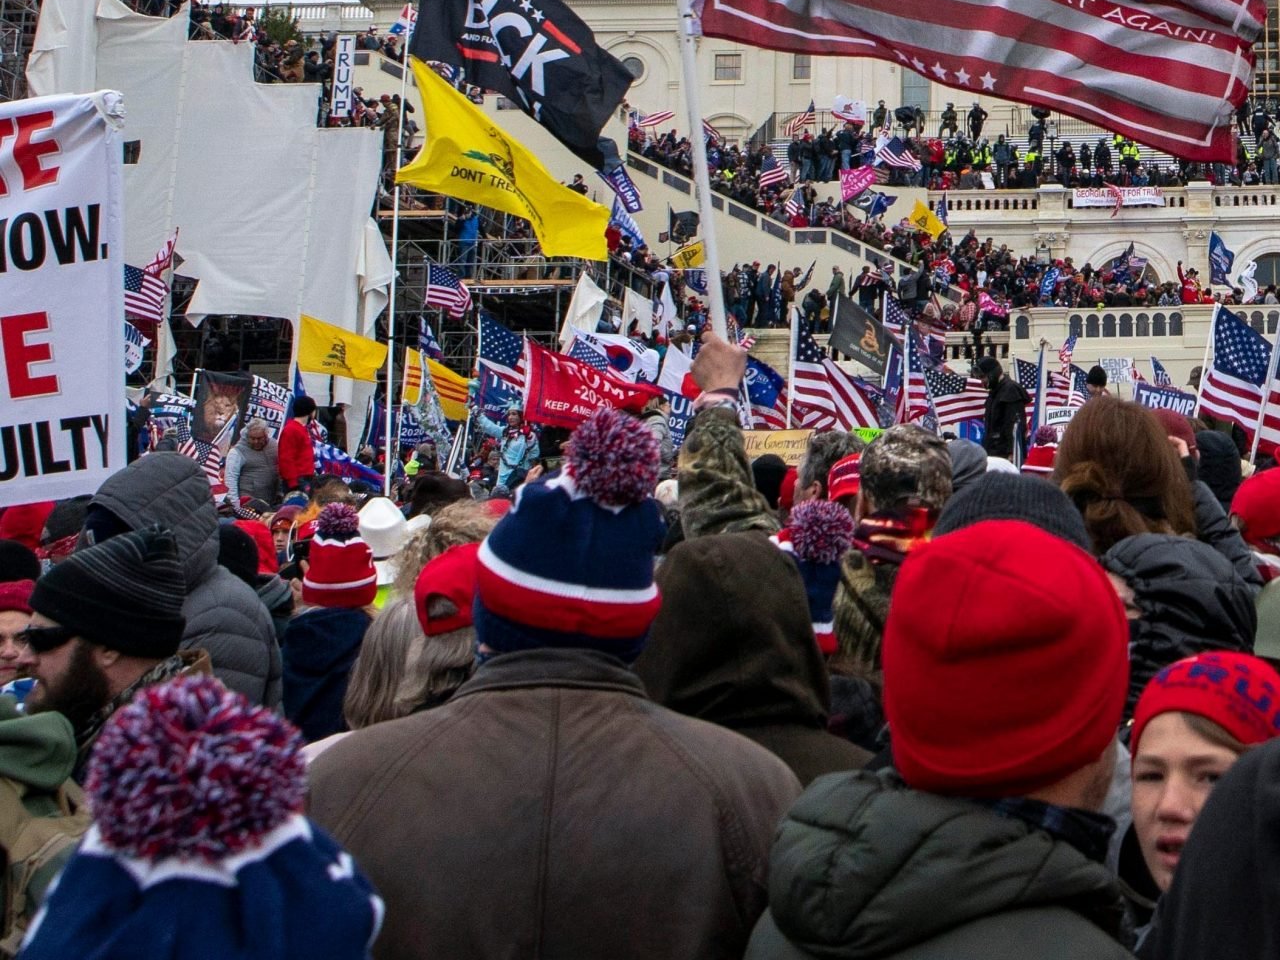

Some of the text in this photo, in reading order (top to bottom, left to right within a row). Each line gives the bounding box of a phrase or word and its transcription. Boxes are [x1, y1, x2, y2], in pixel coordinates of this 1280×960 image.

[1102, 6, 1216, 44] AGAIN!
[335, 38, 352, 116] TRUMP
[613, 166, 639, 211] TRUMP
[1076, 189, 1106, 198] GEORGIA
[1107, 189, 1126, 198] FIGT
[1127, 189, 1141, 197] FOR
[1102, 358, 1128, 368] SEND
[545, 399, 569, 411] KEEP
[1139, 390, 1195, 416] TRUMP
[1048, 409, 1072, 420] BIKERS
